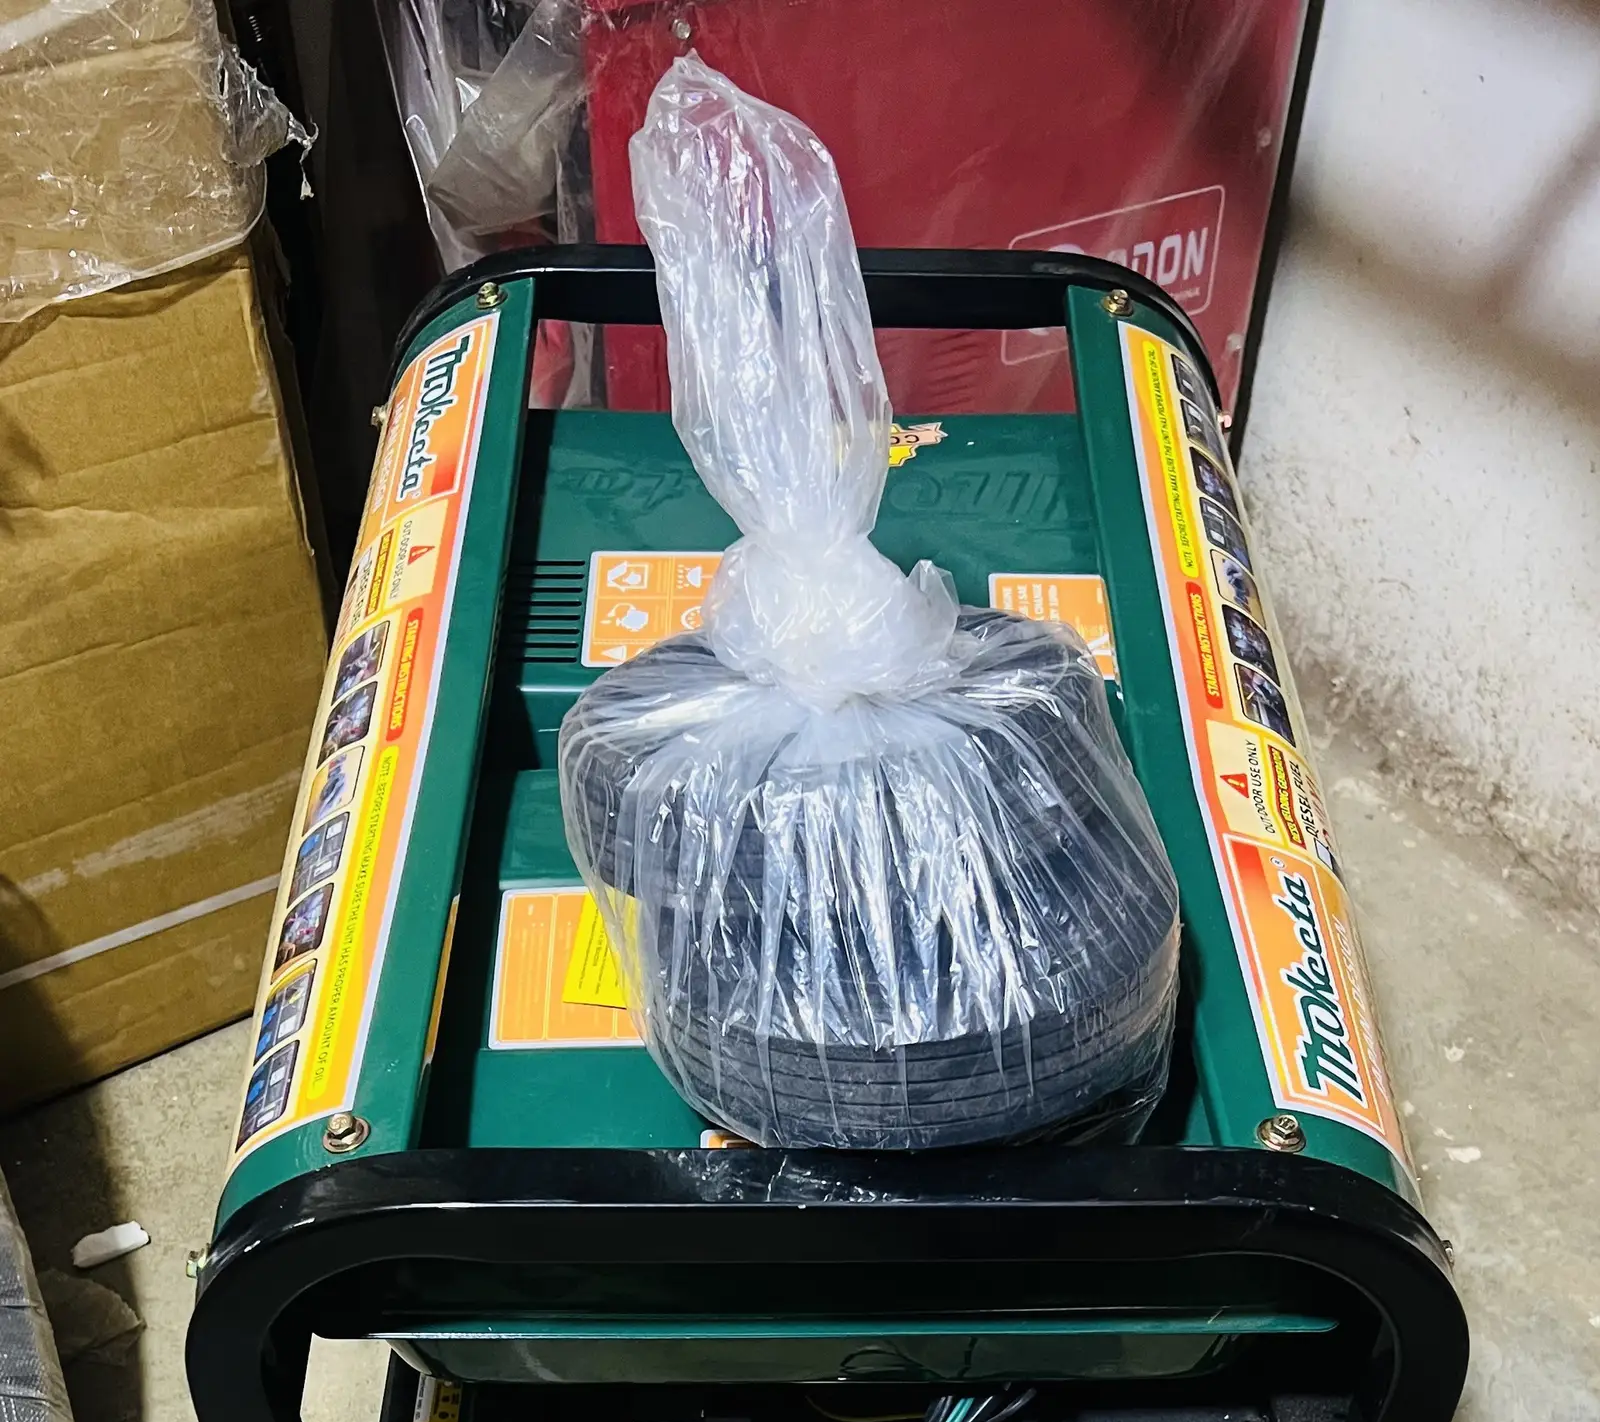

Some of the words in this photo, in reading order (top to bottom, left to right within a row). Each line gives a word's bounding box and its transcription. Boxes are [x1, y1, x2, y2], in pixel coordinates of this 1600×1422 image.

[401, 619, 419, 661] STARTING
[1190, 593, 1211, 652] INSTRUCTIONS
[1201, 653, 1219, 695] STARTING
[1246, 739, 1259, 766] ONLY
[1250, 766, 1262, 787] USE
[1289, 760, 1306, 794] FUEL
[1298, 793, 1319, 839] DIESEL
[362, 815, 379, 856] STARTING
[357, 857, 370, 881] MAKE
[348, 904, 360, 922] THE
[338, 948, 350, 967] HAS
[330, 968, 346, 1004] PROPER
[320, 1007, 338, 1049] AMOUNT
[316, 1051, 328, 1065] OF
